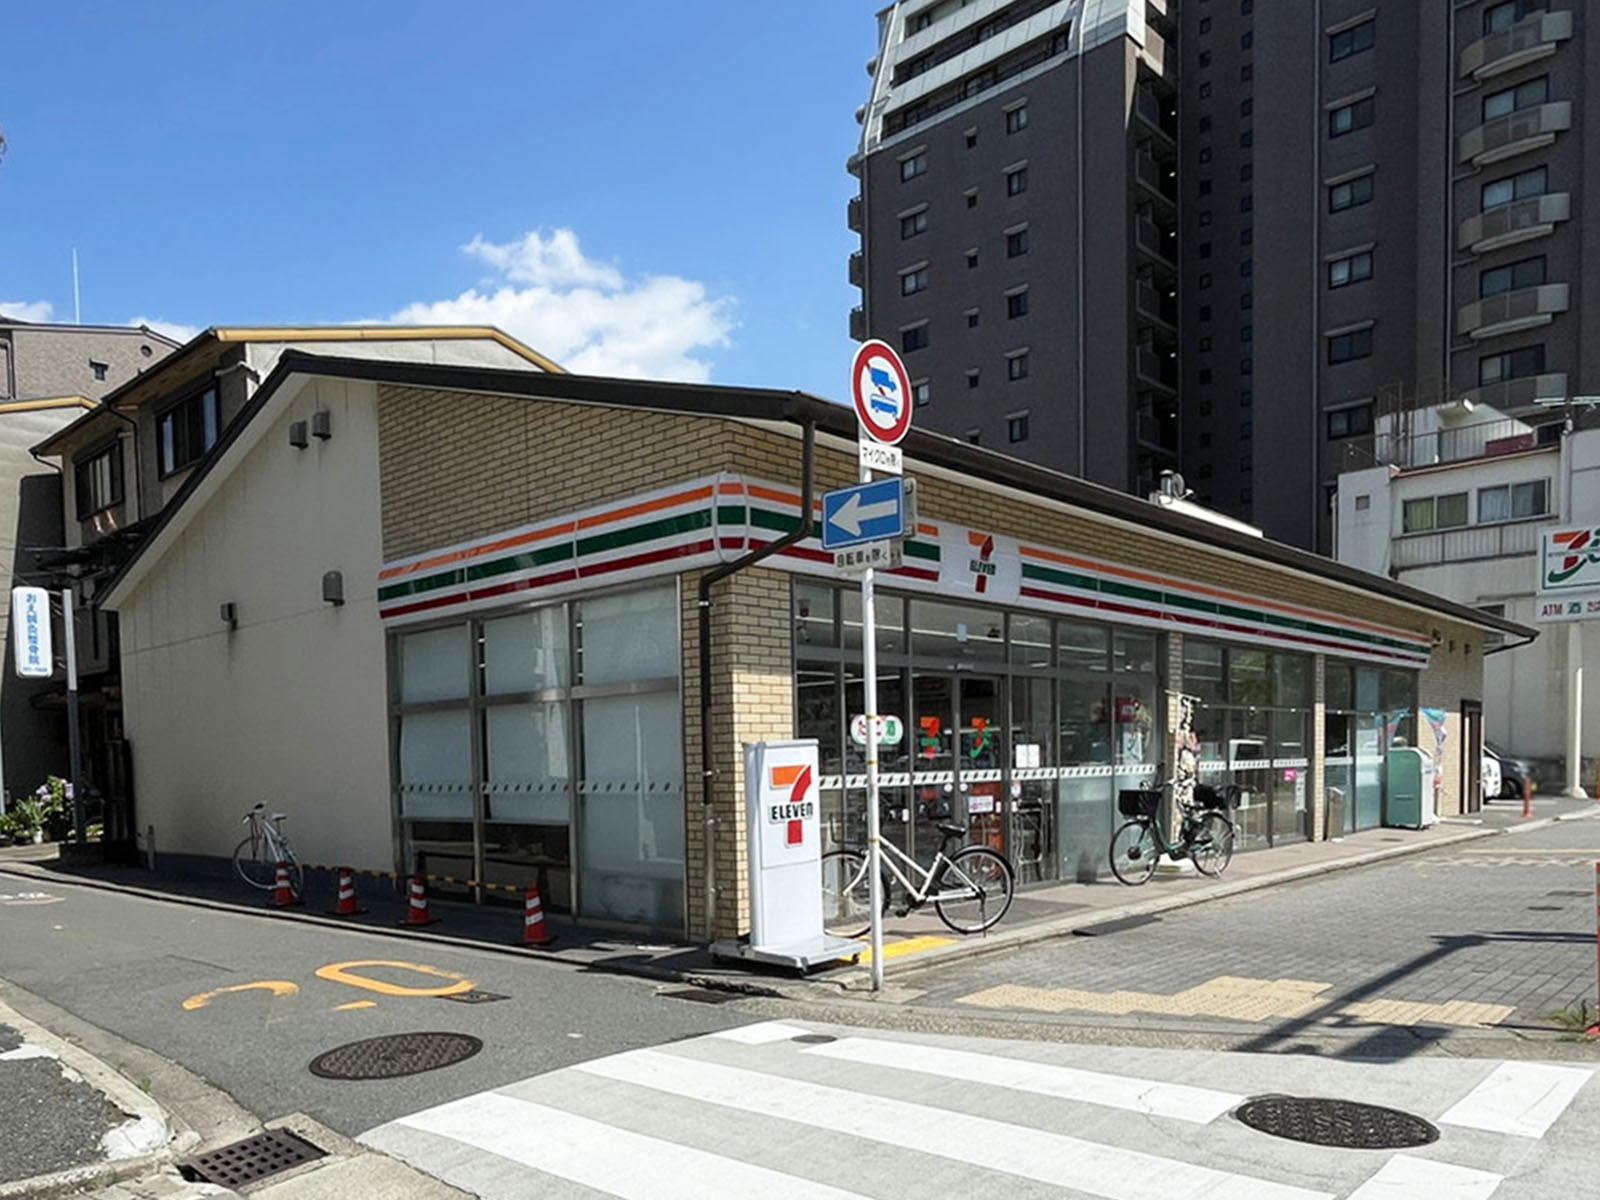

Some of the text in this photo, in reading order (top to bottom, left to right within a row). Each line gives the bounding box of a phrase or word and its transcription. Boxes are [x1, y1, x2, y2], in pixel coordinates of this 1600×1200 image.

[836, 548, 888, 569] 自転車を除く
[1542, 603, 1563, 616] ATM
[771, 764, 812, 845] 7
